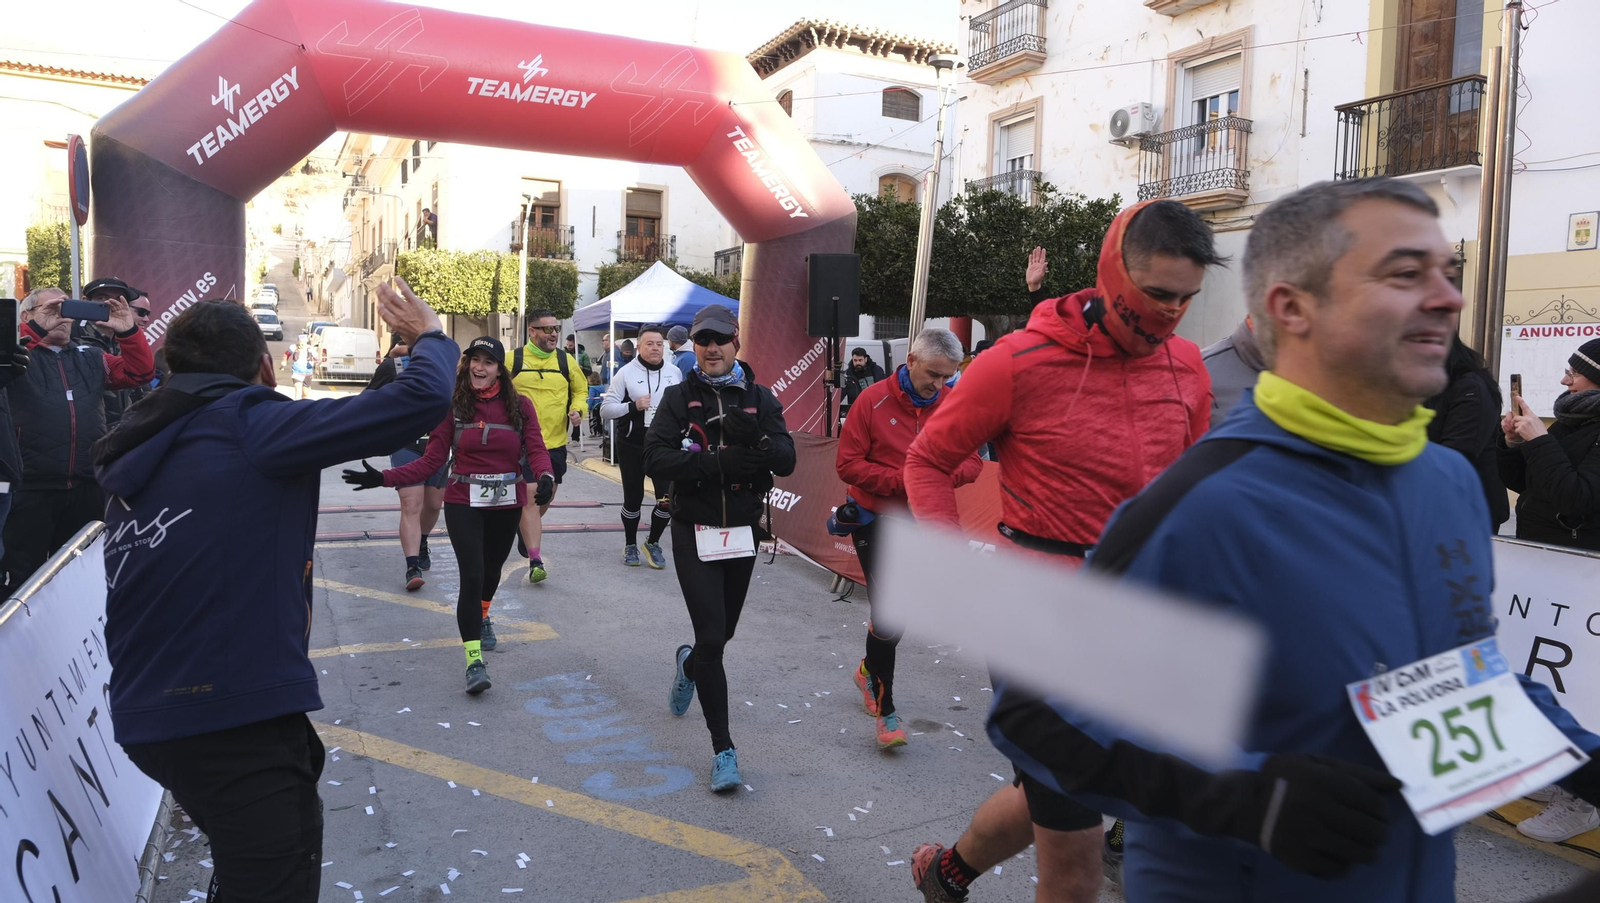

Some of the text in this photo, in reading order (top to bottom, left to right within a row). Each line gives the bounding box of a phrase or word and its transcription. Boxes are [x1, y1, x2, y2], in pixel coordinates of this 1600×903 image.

[186, 65, 299, 166] TEAMERGY
[467, 76, 597, 109] TEAMERGY
[726, 125, 809, 219] TEAMERGY
[118, 543, 132, 551] NON
[135, 537, 152, 547] STOP
[719, 531, 730, 547] 7
[1524, 636, 1573, 694] R
[1411, 695, 1506, 777] 257
[16, 683, 117, 903] CANT
